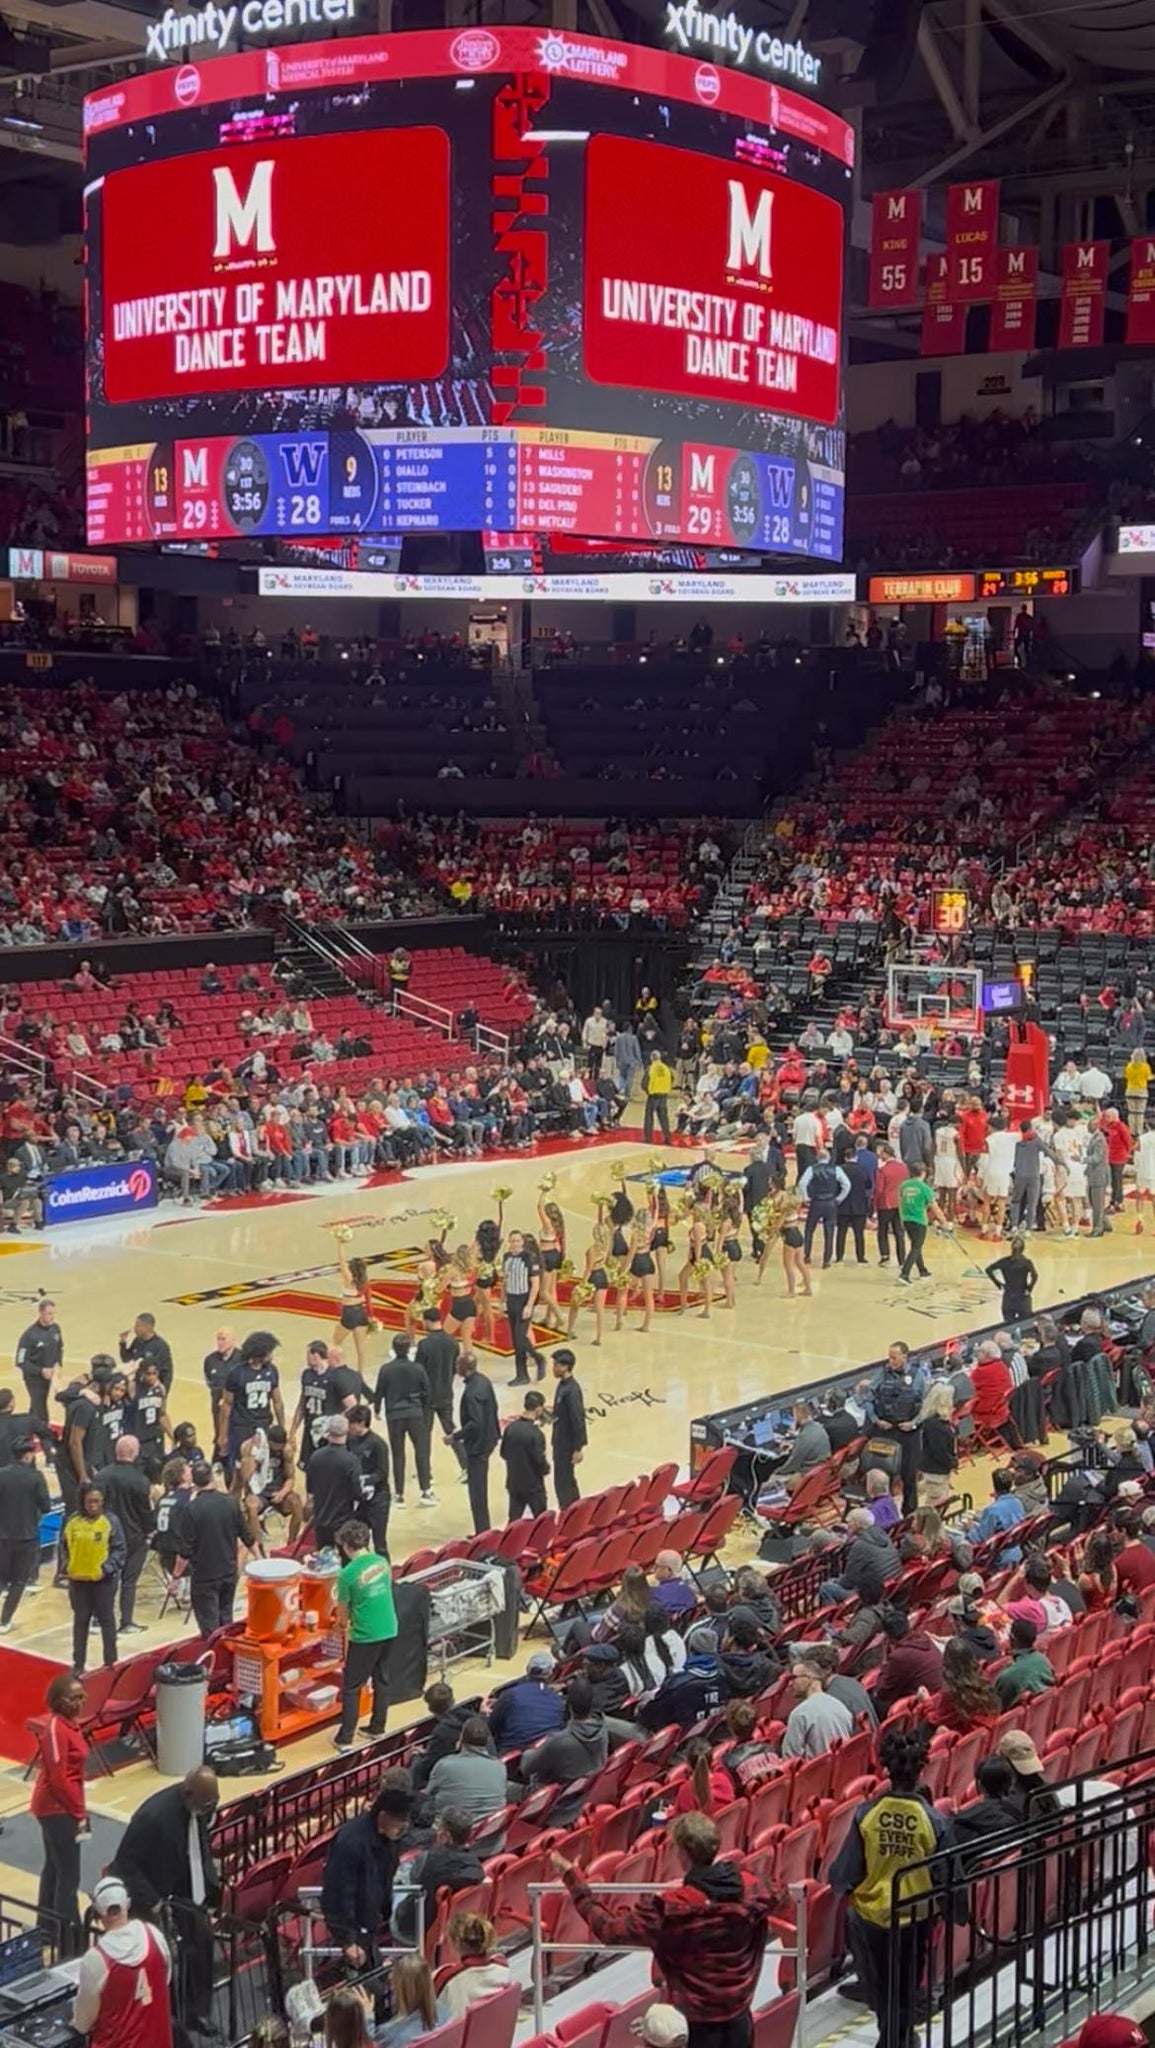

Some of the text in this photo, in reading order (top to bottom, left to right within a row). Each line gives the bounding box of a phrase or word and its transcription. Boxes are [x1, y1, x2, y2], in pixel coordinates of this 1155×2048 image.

[146, 0, 357, 61] xfinity center
[665, 0, 822, 85] xfinity center
[571, 43, 628, 67] MARYLAND
[570, 59, 619, 79] LOTTERY
[212, 159, 276, 257] M
[888, 197, 905, 219] M
[964, 187, 983, 212] M
[726, 179, 774, 278] M
[955, 231, 988, 244] LUCAS
[882, 239, 908, 250] KING
[1008, 252, 1025, 273] M
[1077, 247, 1095, 268] M
[882, 265, 907, 291] 55
[958, 257, 983, 284] 15
[113, 270, 432, 341] UNIVERSITY OF MARYLAND
[602, 277, 836, 366] UNIVERSITY OF MARYLAND
[175, 322, 326, 374] DANCE TEAM
[686, 334, 798, 393] DANCE TEAM
[396, 431, 428, 442] PLAYER
[481, 429, 499, 441] PTS
[539, 431, 569, 444] PLAYER
[240, 456, 253, 471] 30
[280, 442, 328, 487] W
[383, 448, 391, 461] 0
[396, 448, 444, 461] PETERSON
[486, 447, 493, 459] 5
[525, 448, 532, 459] 7
[538, 448, 565, 461] MILLS
[182, 447, 209, 488] M
[346, 455, 357, 482] 9
[383, 464, 391, 477] 5
[396, 464, 429, 477] DIALLO
[484, 464, 497, 476] 10
[525, 465, 532, 476] 9
[690, 452, 715, 494] M
[154, 467, 168, 492] 13
[396, 481, 447, 494] STEINBACH
[486, 480, 493, 493] 2
[523, 482, 535, 494] 13
[656, 465, 673, 492] 13
[767, 464, 795, 509] W
[232, 492, 261, 511] 3:56
[396, 498, 432, 510] TUCKER
[485, 497, 493, 510] 0
[801, 484, 808, 509] 9
[183, 500, 207, 529] 29
[291, 494, 321, 525] 28
[352, 513, 361, 527] 4
[382, 515, 393, 526] 11
[486, 514, 493, 526] 4
[687, 505, 711, 535] 29
[733, 505, 755, 524] 3:56
[521, 515, 535, 527] 45
[656, 521, 662, 535] 3
[772, 515, 790, 544] 28
[71, 562, 110, 576] TOYOTA
[883, 579, 961, 596] TERRAPIN CLUB
[936, 907, 963, 929] 30
[49, 1182, 130, 1209] CohnReznick
[247, 1391, 268, 1410] 24
[306, 1396, 322, 1415] 41
[145, 1407, 156, 1425] 9
[157, 1506, 170, 1532] 6
[879, 1811, 917, 1831] CSC
[879, 1830, 915, 1846] EVENT
[879, 1843, 915, 1859] STAFF
[134, 1967, 153, 2007] 4
